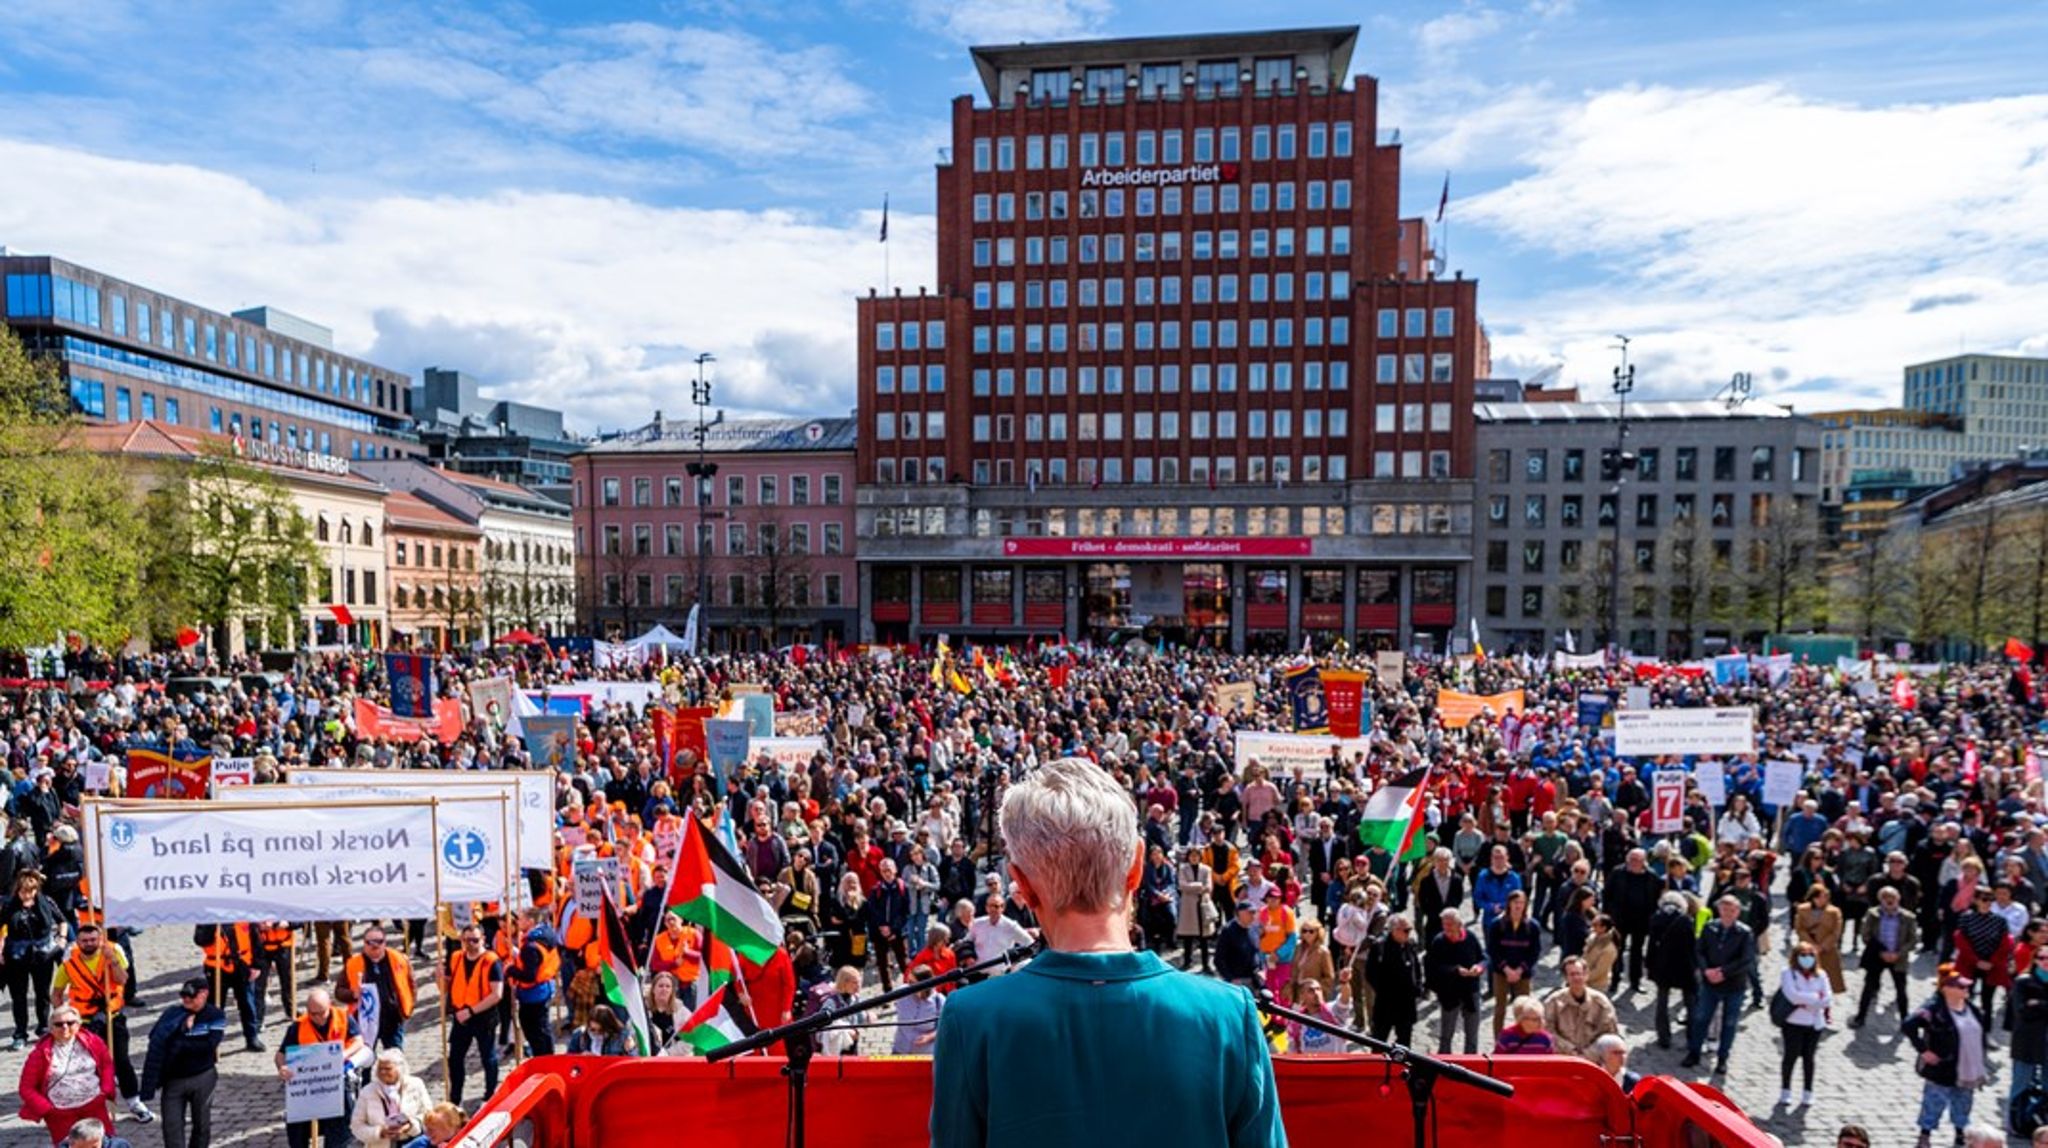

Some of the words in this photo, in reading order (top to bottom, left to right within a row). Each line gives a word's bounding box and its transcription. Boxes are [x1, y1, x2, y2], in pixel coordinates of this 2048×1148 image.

[1081, 164, 1220, 186] Arbeiderpartiet
[697, 424, 795, 444] uristforening
[1527, 456, 1694, 474] STTT
[1489, 501, 1728, 520] UKRAINA
[1072, 541, 1106, 552] Frihet
[1115, 541, 1173, 552] demokrati
[1182, 541, 1241, 552] solidaritet
[215, 760, 250, 771] Pulje
[1660, 789, 1679, 817] 7
[297, 1065, 319, 1074] Krav
[290, 1088, 307, 1097] ved
